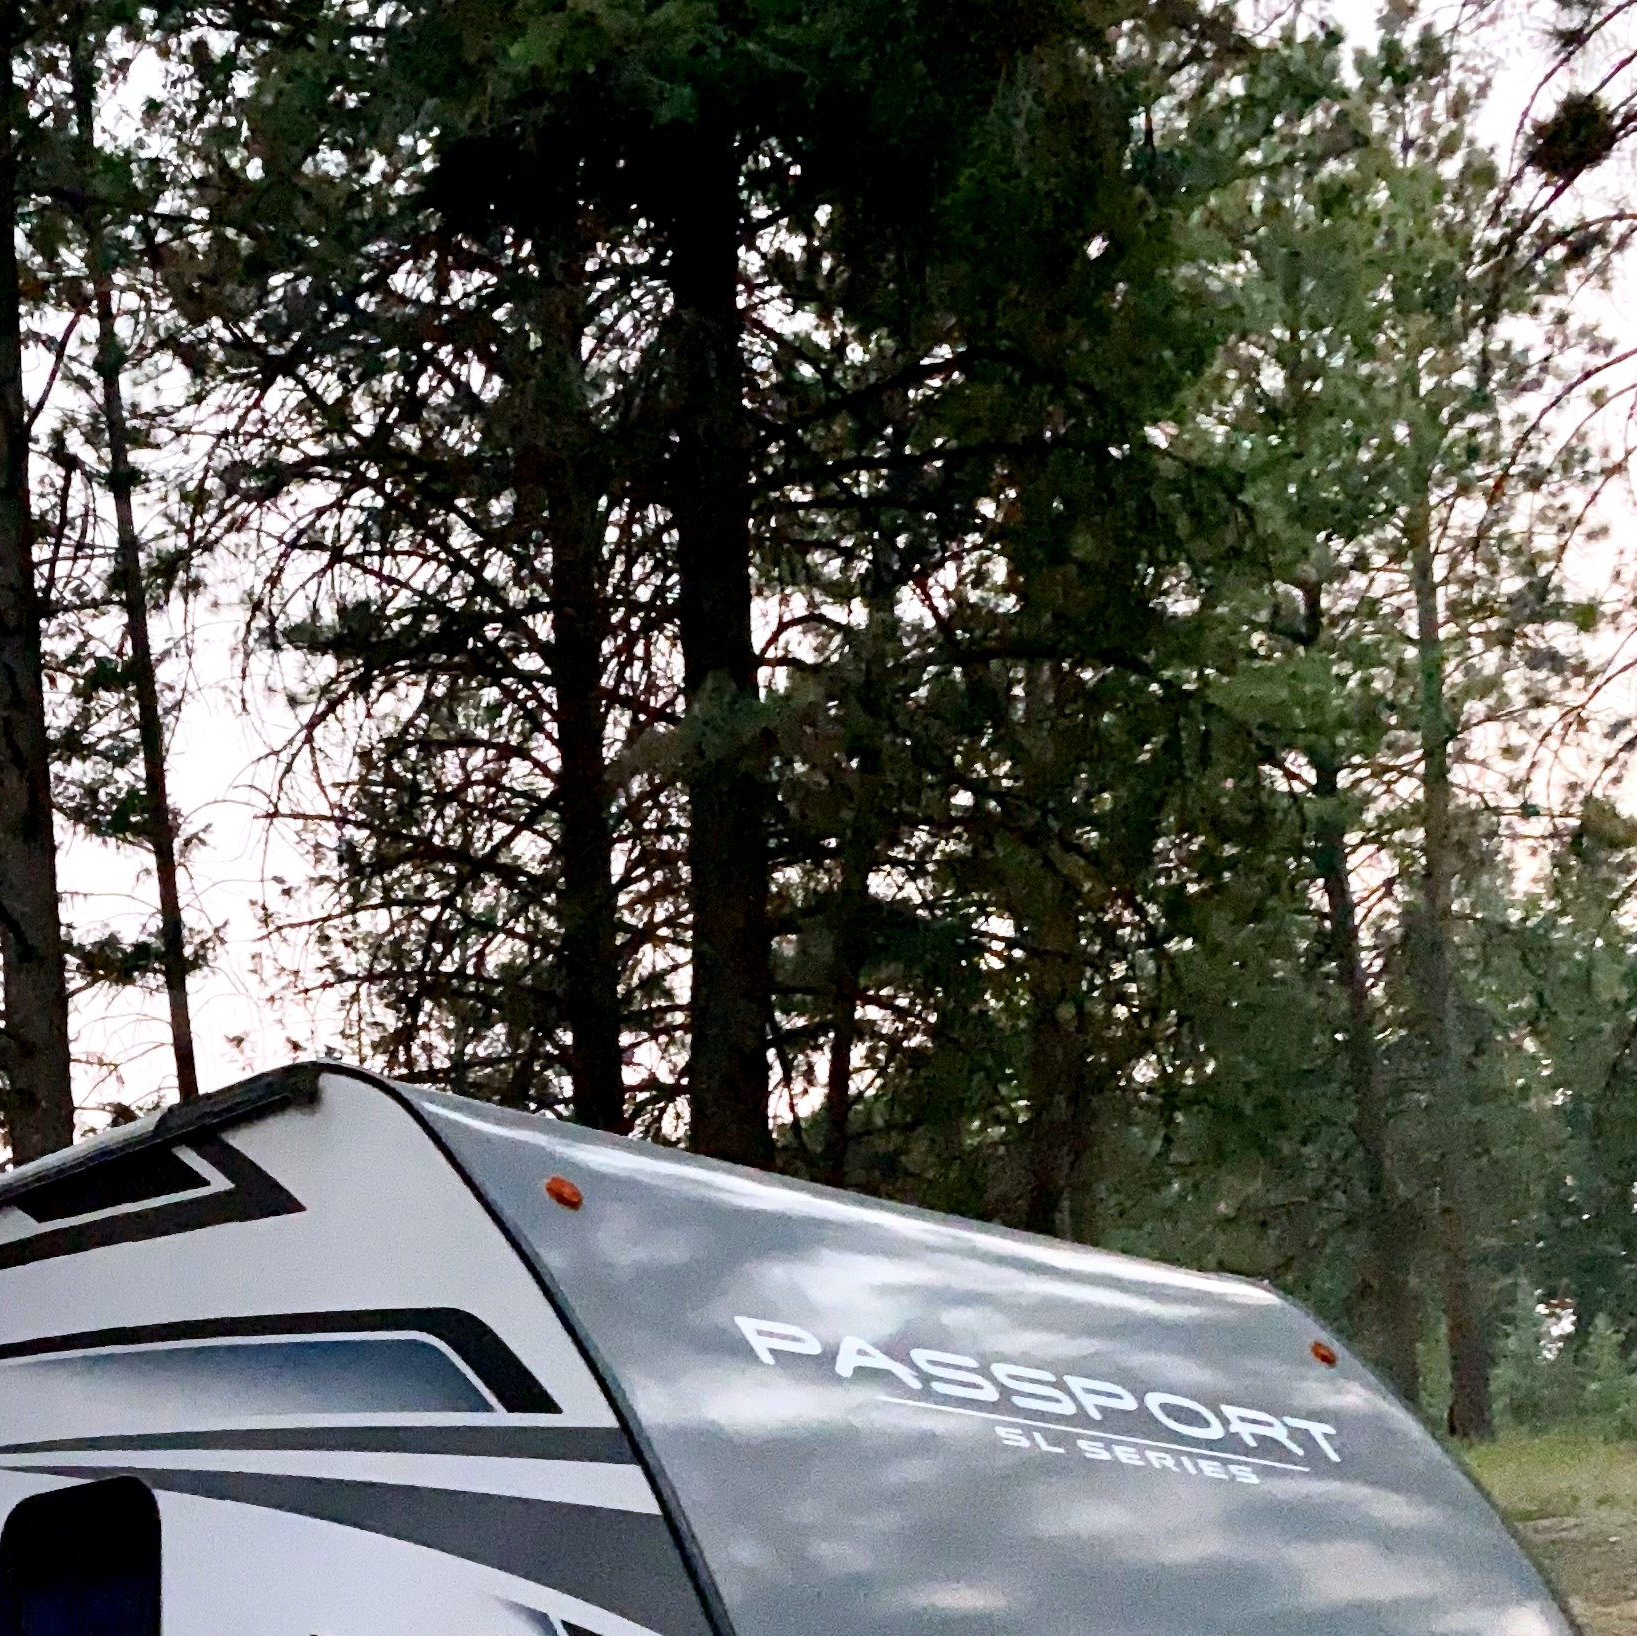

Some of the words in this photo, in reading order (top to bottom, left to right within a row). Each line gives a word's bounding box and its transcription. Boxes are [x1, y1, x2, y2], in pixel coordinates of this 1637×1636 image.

[733, 1314, 1342, 1463] PASSPORT
[994, 1426, 1064, 1454] SL
[1077, 1437, 1261, 1485] SERIES
